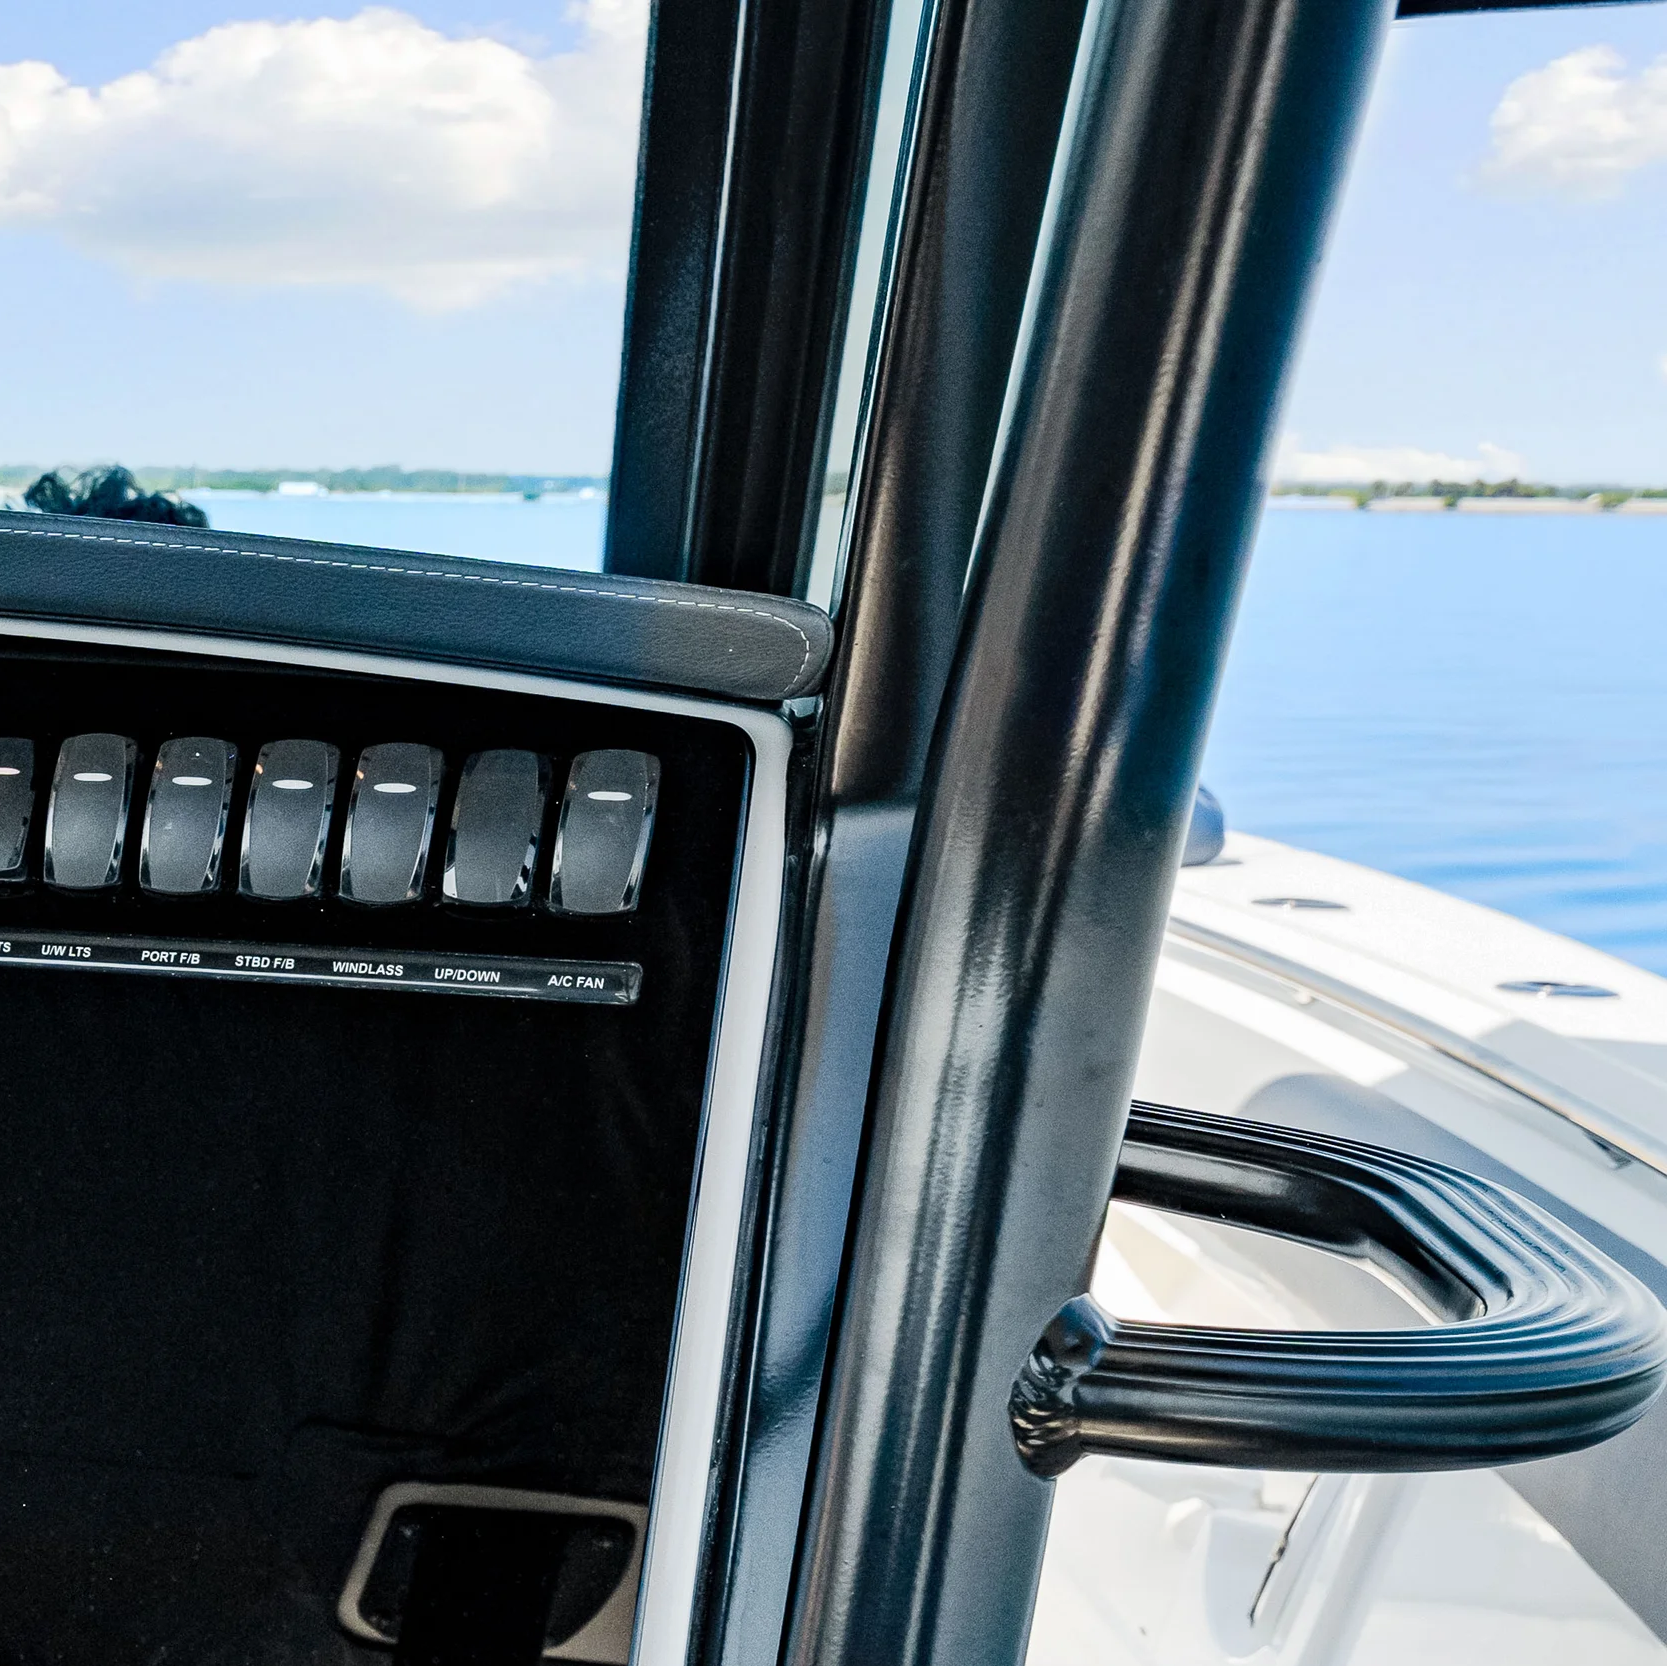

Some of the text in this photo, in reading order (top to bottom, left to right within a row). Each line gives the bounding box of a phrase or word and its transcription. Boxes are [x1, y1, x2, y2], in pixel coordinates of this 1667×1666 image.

[41, 945, 91, 957] U/W LTS
[141, 951, 200, 964] PORT F/B
[235, 956, 294, 969] STBD F/B
[332, 961, 403, 976] WINDLASS
[434, 968, 500, 982] UP/DOWN
[548, 975, 604, 989] A/C FAN
